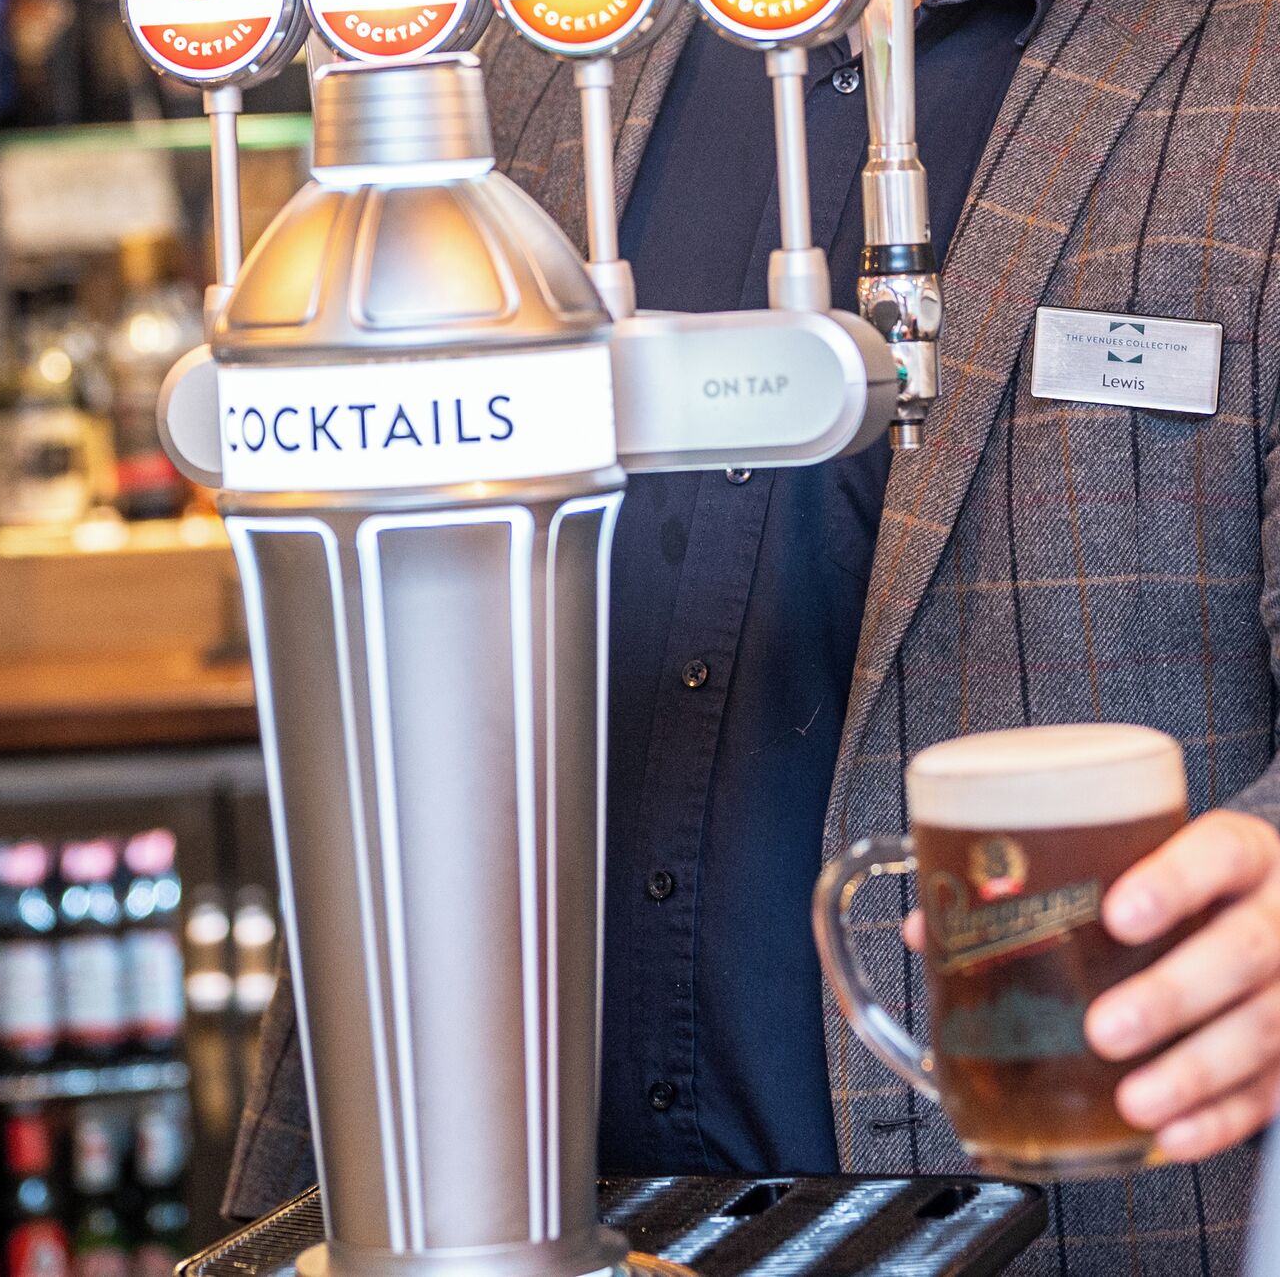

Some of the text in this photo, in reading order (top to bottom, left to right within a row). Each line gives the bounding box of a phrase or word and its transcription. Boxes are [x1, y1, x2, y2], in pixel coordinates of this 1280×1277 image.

[163, 23, 252, 56] COCKTAIL
[345, 9, 438, 42] COCKTAIL
[1066, 334, 1188, 352] THE VENUES COLLECTION
[703, 374, 789, 399] ON TAP
[1102, 374, 1145, 390] Lewis
[224, 395, 514, 452] COCKTAILS
